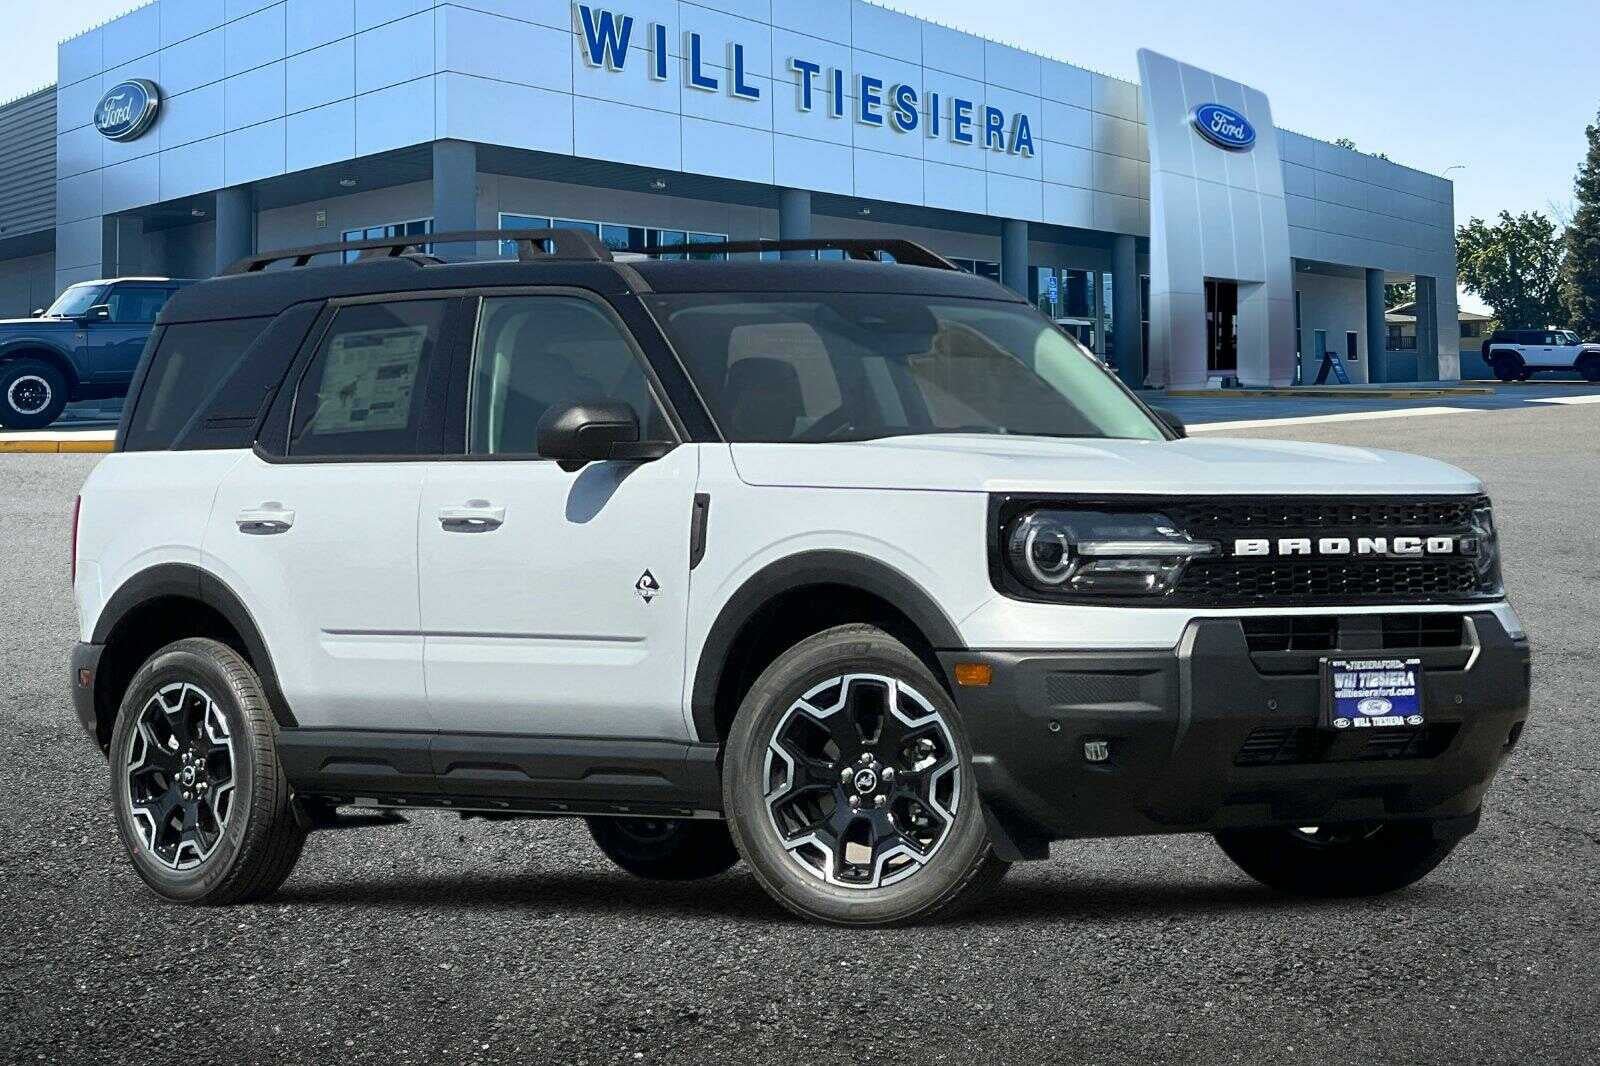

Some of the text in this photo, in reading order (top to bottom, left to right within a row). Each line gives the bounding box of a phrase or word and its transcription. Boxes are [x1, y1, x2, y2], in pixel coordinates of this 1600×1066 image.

[576, 4, 1035, 158] WILL TIESIERA
[101, 93, 133, 128] Ford
[1211, 111, 1245, 139] Ford
[1234, 537, 1453, 556] BRONCO
